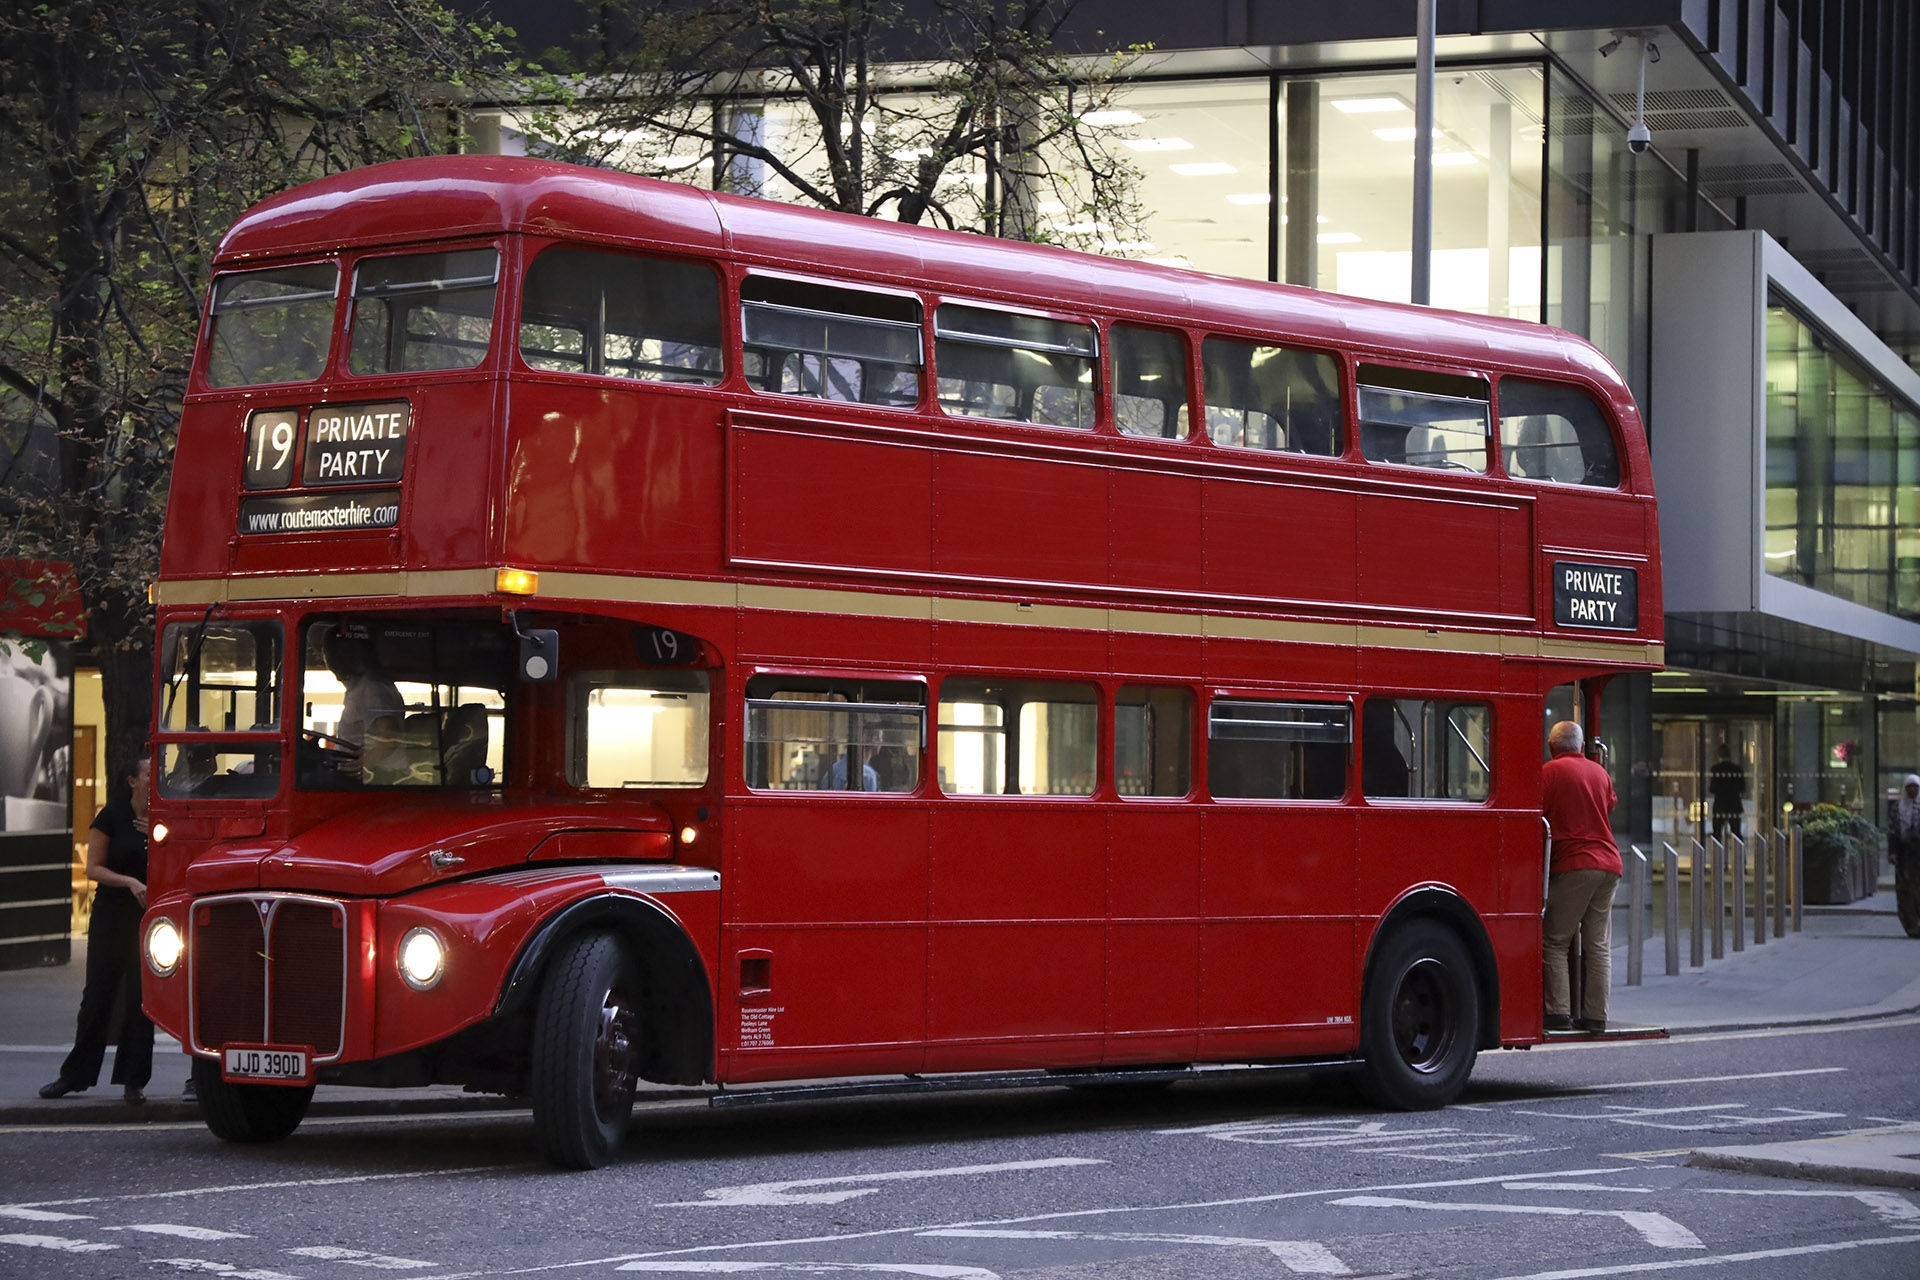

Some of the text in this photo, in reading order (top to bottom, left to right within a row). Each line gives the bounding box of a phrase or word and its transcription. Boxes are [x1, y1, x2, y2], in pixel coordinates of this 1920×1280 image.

[316, 413, 401, 443] PRIVATE
[255, 422, 293, 471] 19
[319, 449, 390, 478] PARTY
[249, 500, 398, 530] www.routemasterhire.com
[1565, 570, 1622, 595] PRIVATE
[1570, 598, 1617, 622] PARTY
[652, 630, 678, 659] 19
[233, 1053, 300, 1075] JJD 390D
